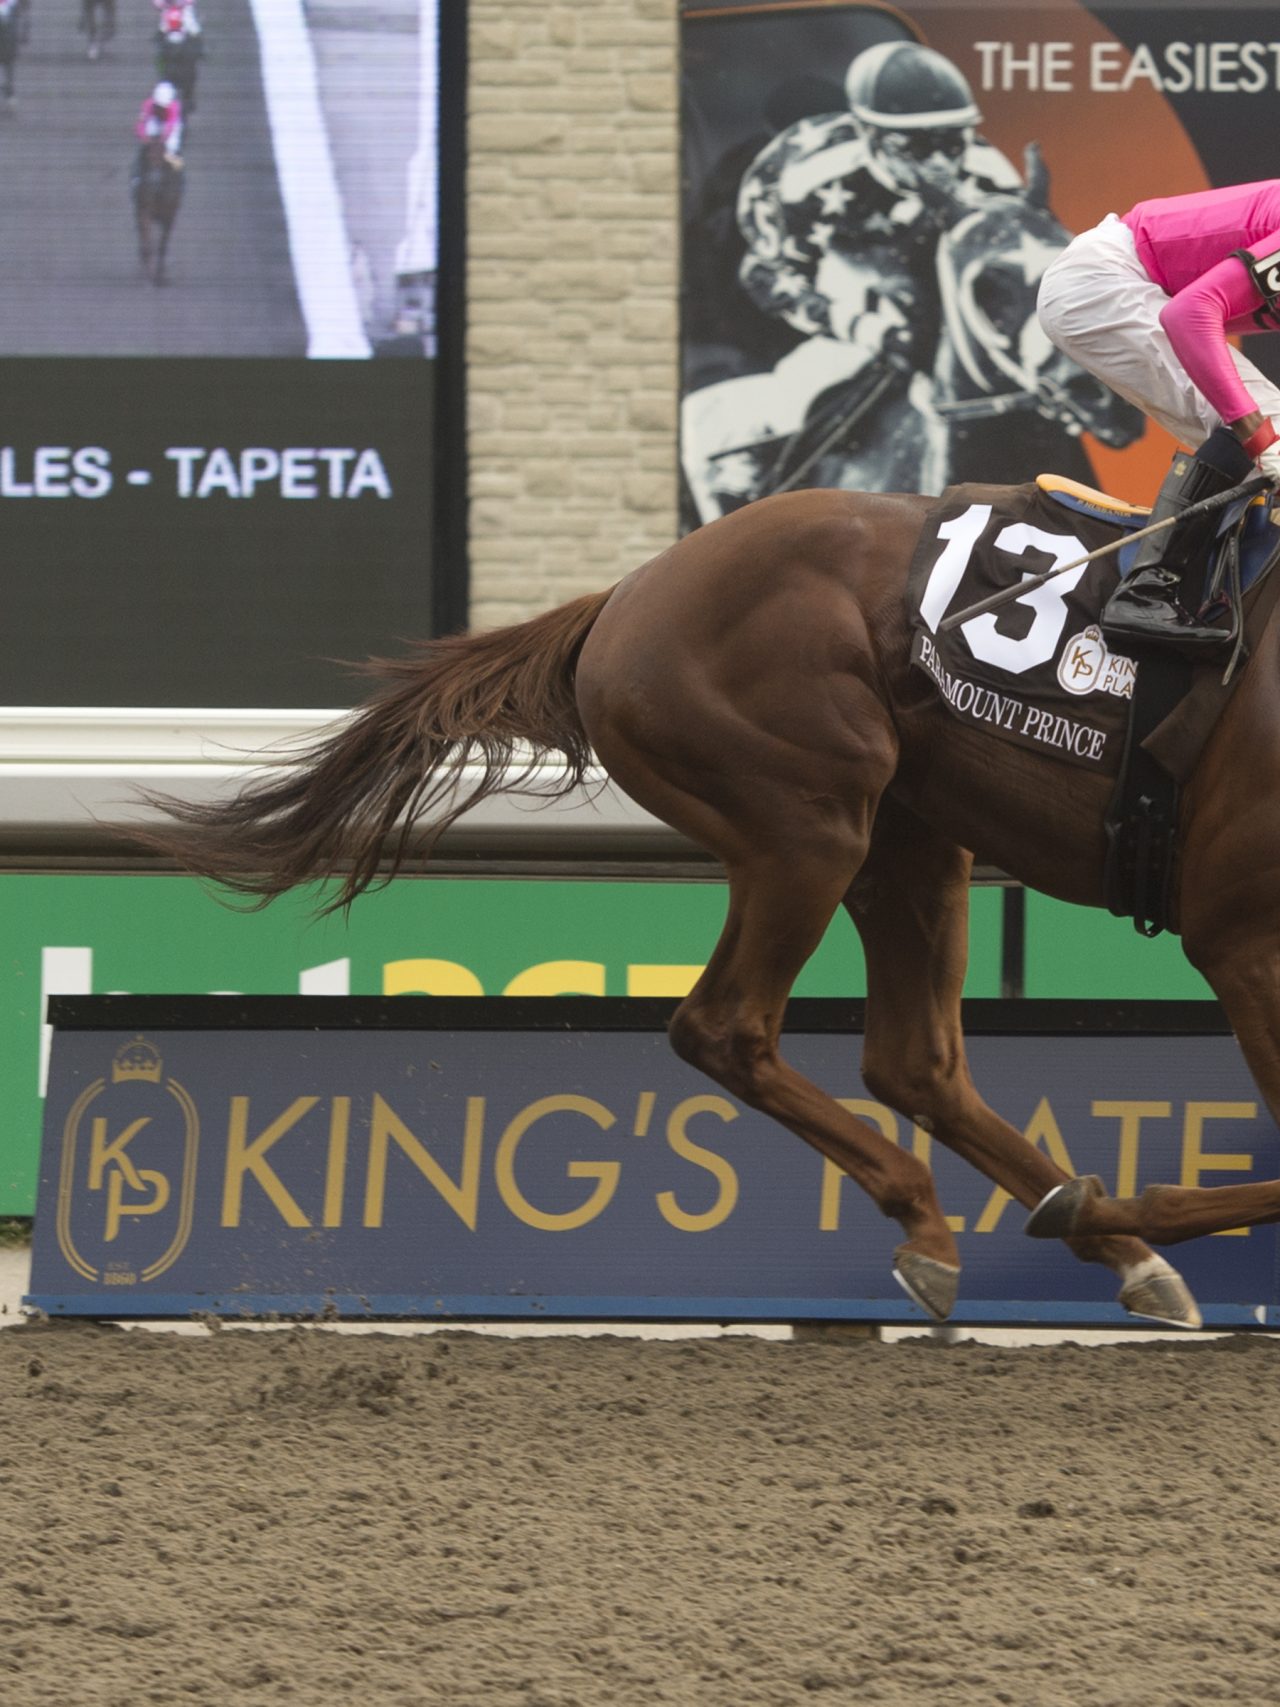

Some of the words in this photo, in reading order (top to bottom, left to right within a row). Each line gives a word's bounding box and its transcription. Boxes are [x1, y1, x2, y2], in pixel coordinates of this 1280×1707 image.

[974, 42, 1073, 92] THE
[165, 447, 391, 499] TAPETA
[919, 504, 1091, 675] 13
[919, 635, 1022, 730] PARAMOUNT
[1020, 706, 1107, 760] PRINCE
[220, 1091, 739, 1233] KING'S
